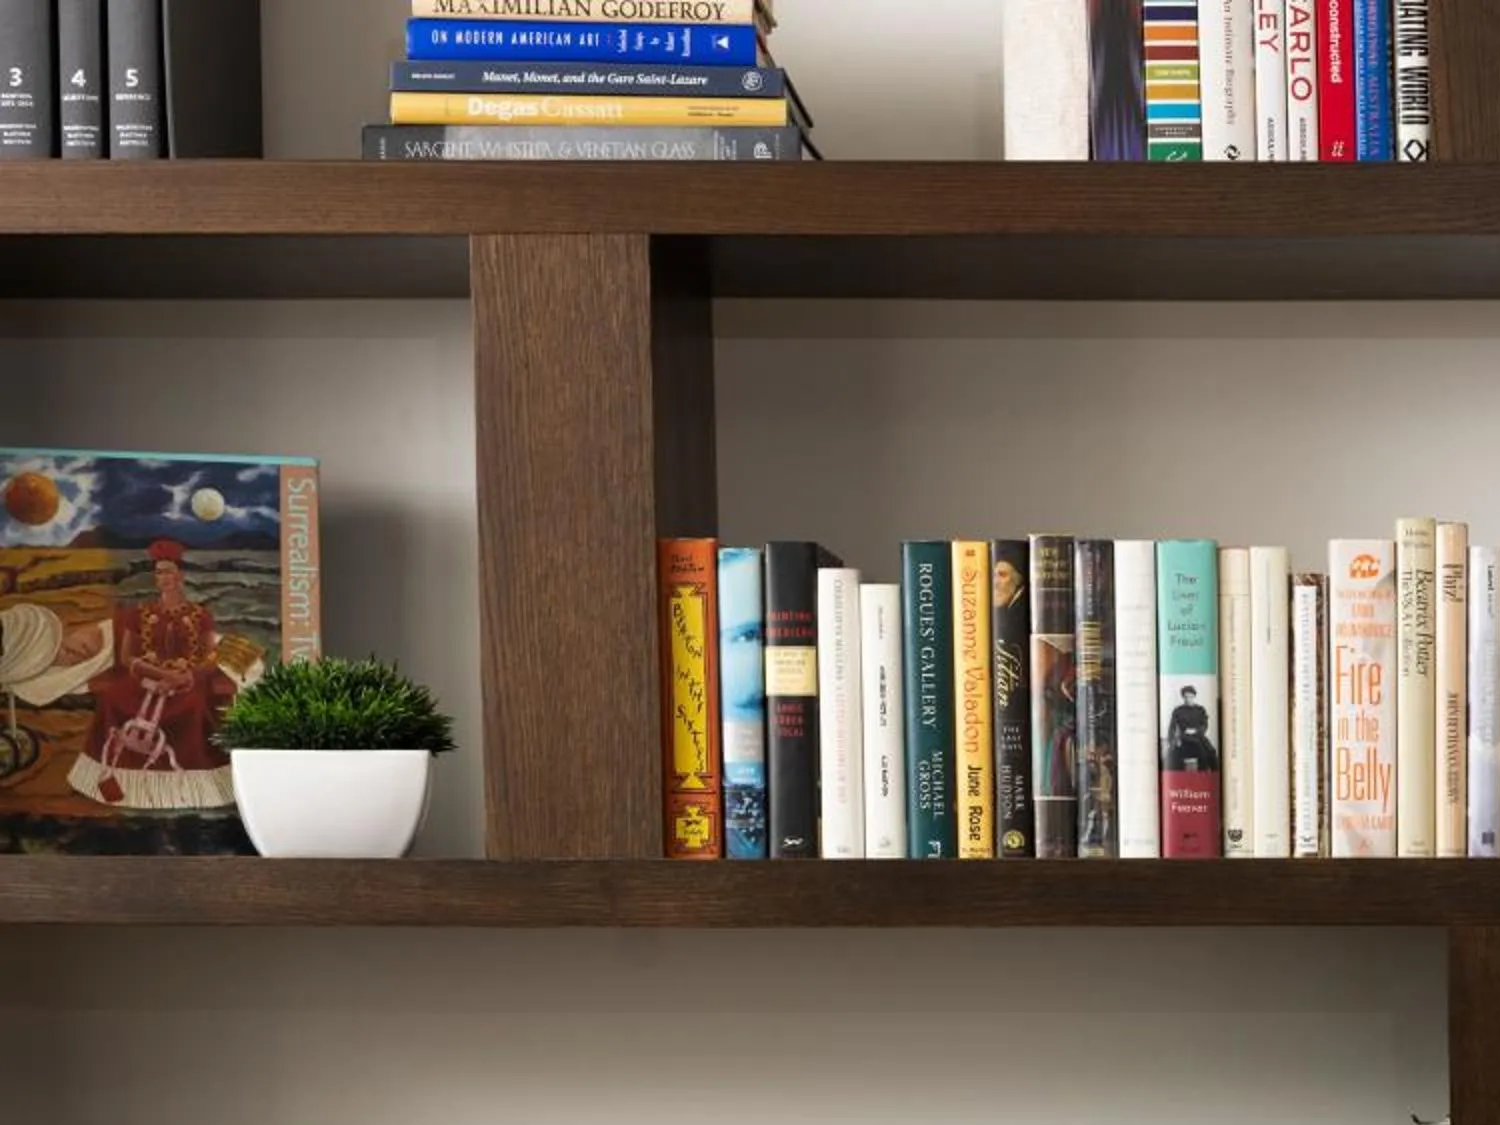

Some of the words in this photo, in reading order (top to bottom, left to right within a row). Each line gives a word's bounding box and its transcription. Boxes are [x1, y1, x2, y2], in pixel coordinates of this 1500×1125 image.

[601, 0, 724, 20] GODEFROY
[432, 30, 447, 45] ON
[456, 31, 504, 45] MODERN
[511, 32, 572, 46] AMERICAN
[9, 67, 23, 87] 3
[71, 69, 86, 88] 4
[125, 68, 139, 87] 5
[562, 72, 585, 83] and
[587, 72, 605, 84] the
[1400, 65, 1430, 125] WORLD
[467, 97, 540, 121] Degas
[287, 478, 319, 627] Surrealism:
[918, 563, 935, 641] ROGUES'
[961, 567, 980, 660] Suzanne
[1415, 569, 1434, 629] Beatrix
[1335, 645, 1382, 706] Fire
[1415, 632, 1434, 677] Potter
[921, 646, 937, 728] GALLERY
[963, 665, 984, 753] Valadon
[1337, 714, 1349, 741] in
[1354, 708, 1379, 742] the
[920, 760, 932, 810] GROSS
[931, 751, 944, 819] MICHAEL
[967, 764, 982, 797] June
[1001, 765, 1013, 819] HUDSON
[1015, 774, 1024, 810] MARK
[1335, 746, 1393, 813] Belly
[969, 805, 983, 841] Rose
